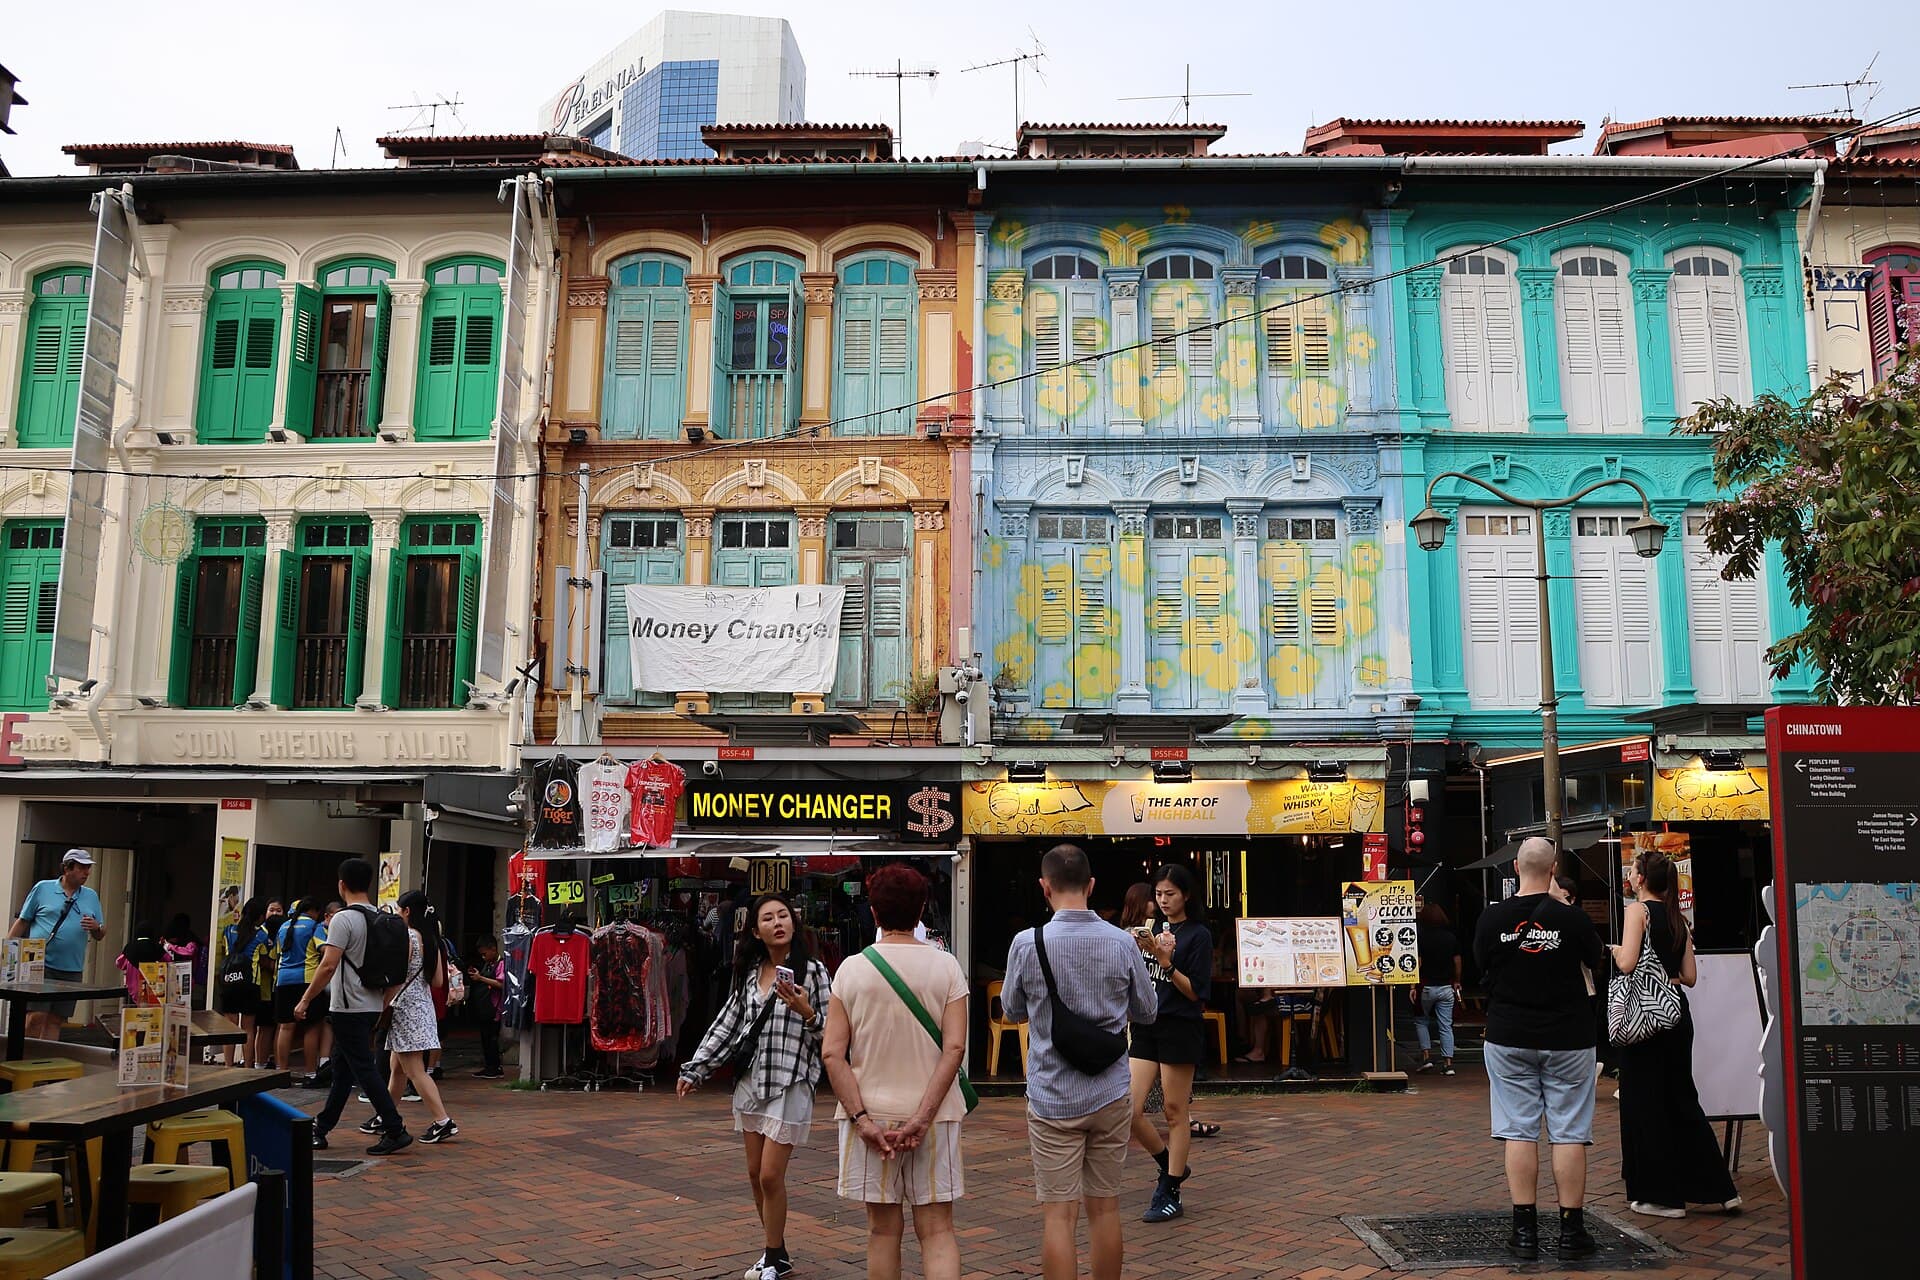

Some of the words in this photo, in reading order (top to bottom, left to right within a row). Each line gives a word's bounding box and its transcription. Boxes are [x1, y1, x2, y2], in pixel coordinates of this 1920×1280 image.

[553, 56, 646, 134] PERENNIAL
[735, 311, 756, 320] SPA
[632, 617, 719, 643] Money
[728, 618, 837, 643] Changer
[1786, 724, 1842, 735] CHINATOWN
[174, 729, 236, 759] SOON
[256, 730, 356, 760] CHEONG
[376, 731, 472, 760] TAILOR
[721, 749, 750, 757] PSSF-44
[1154, 750, 1184, 758] PSSF-42
[1300, 782, 1328, 793] WAYS
[693, 793, 774, 818] MONEY
[779, 794, 891, 819] CHANGER
[1148, 797, 1172, 807] THE
[1174, 797, 1199, 807] ART
[1201, 797, 1219, 807] OF
[1283, 798, 1323, 811] WHISKY
[543, 807, 574, 824] Tiger
[1147, 809, 1217, 820] HIGHBALL
[751, 860, 768, 892] 10
[775, 861, 789, 891] 10
[549, 883, 560, 900] 3
[568, 882, 583, 900] 10
[1389, 886, 1406, 894] IT'S
[1378, 906, 1413, 917] CLOCK
